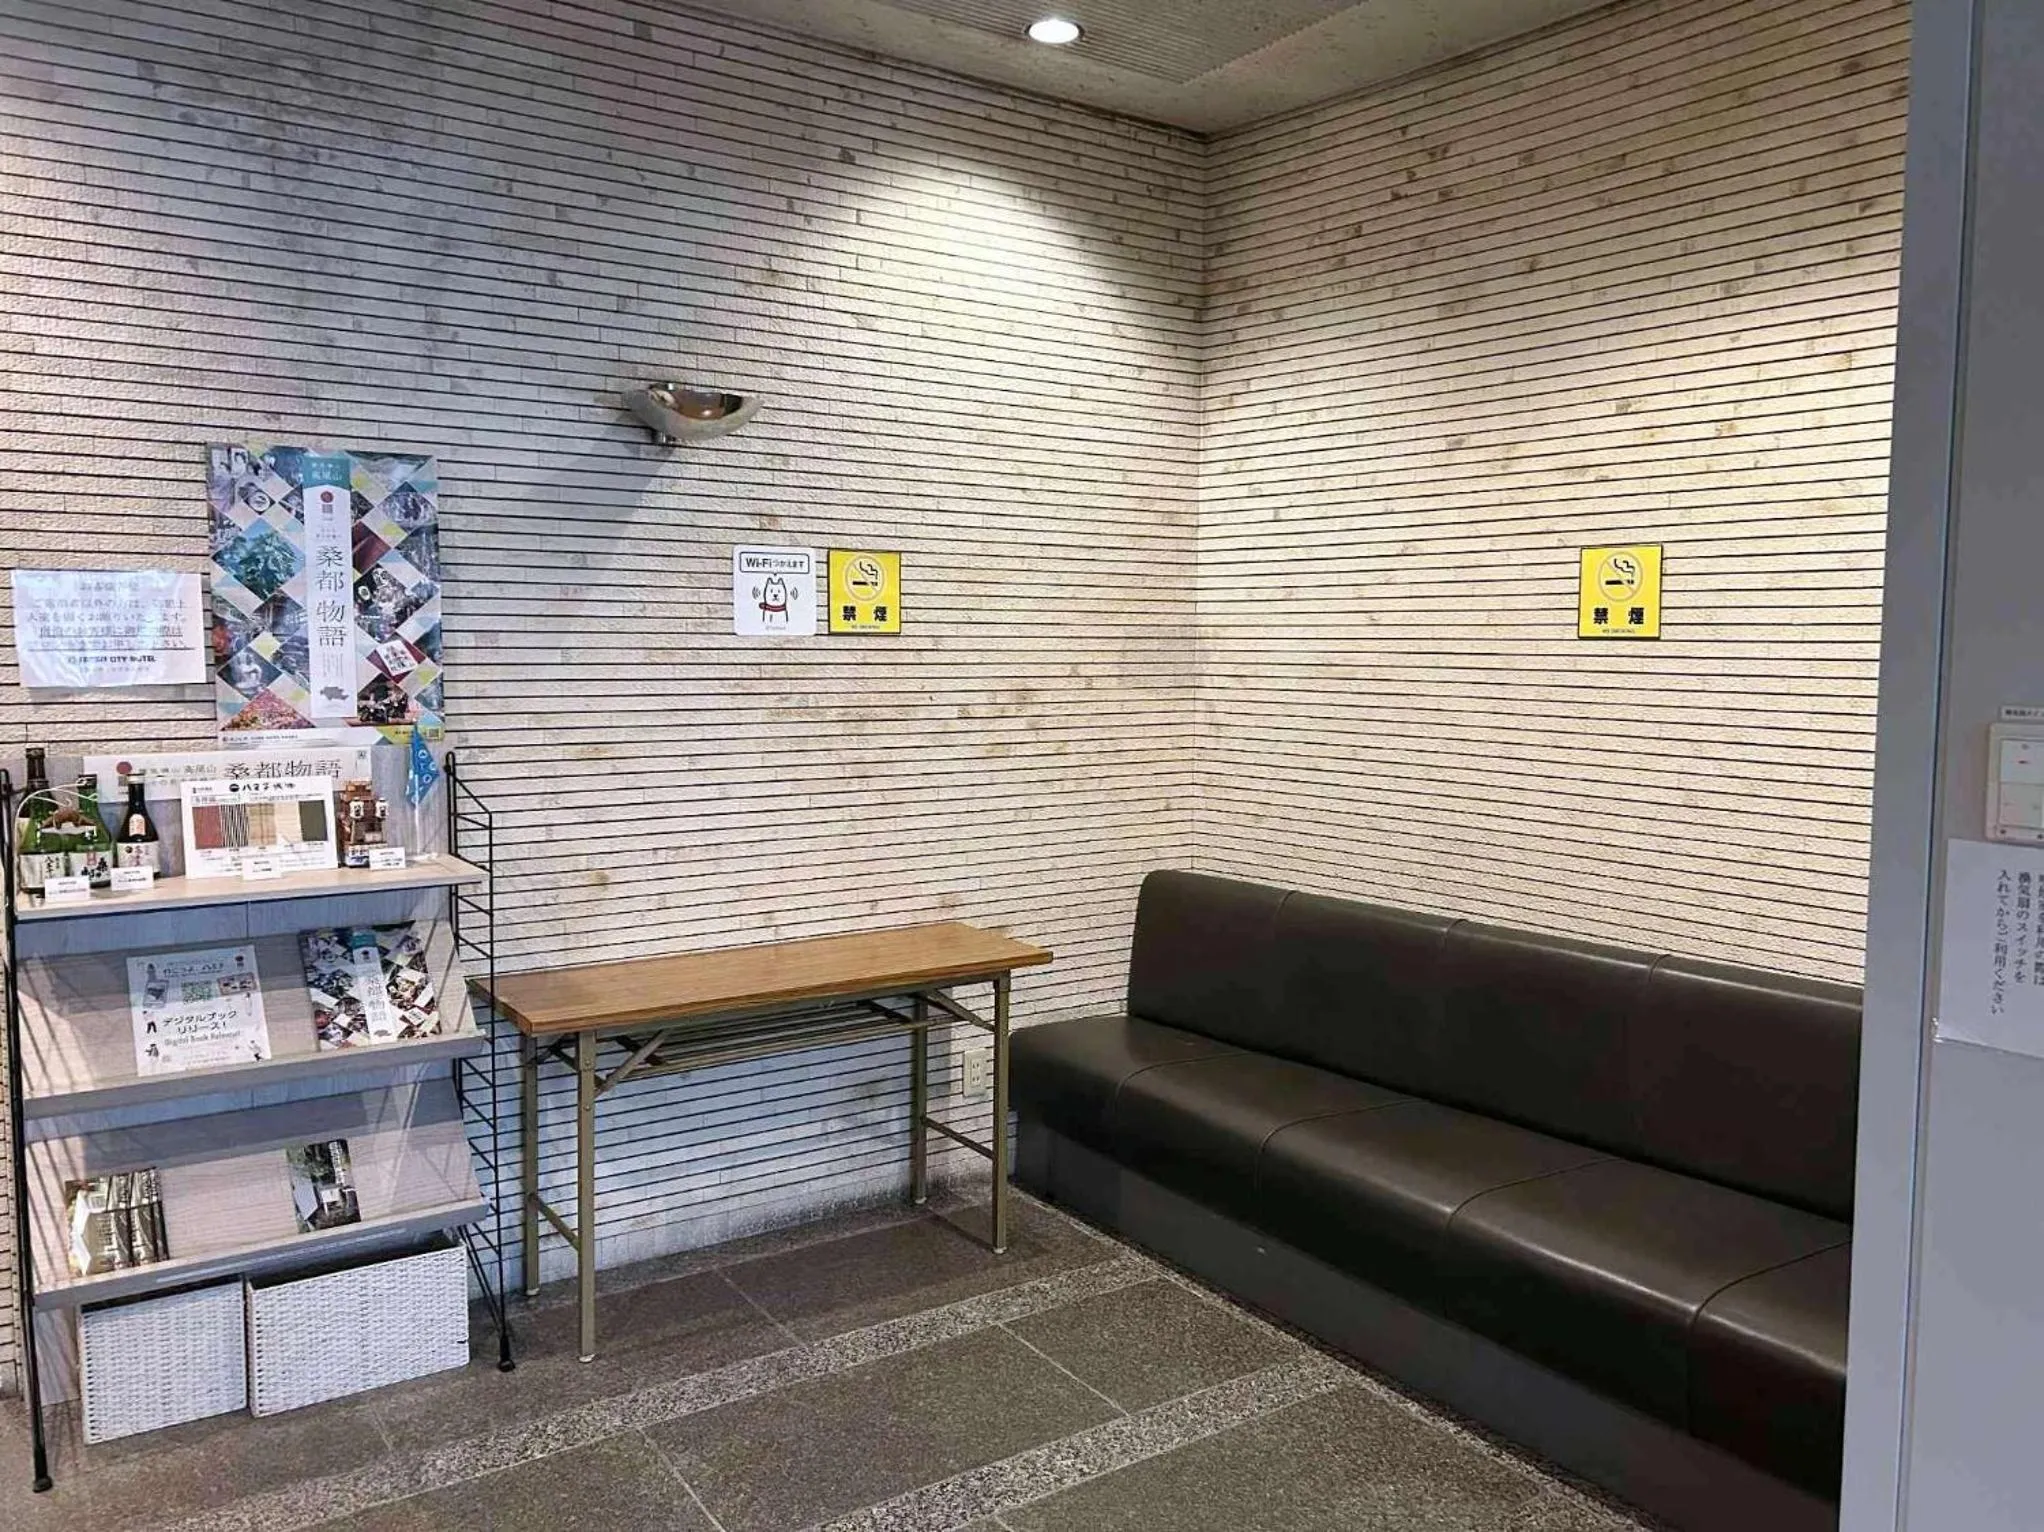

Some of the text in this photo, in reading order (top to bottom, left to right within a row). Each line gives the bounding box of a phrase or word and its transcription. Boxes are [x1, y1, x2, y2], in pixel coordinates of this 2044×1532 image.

[315, 545, 346, 648] 桑都物語
[842, 605, 888, 621] 禁煙
[1593, 607, 1645, 625] 禁煙
[224, 758, 342, 780] 桑都物語
[162, 1010, 237, 1027] デジタルブック
